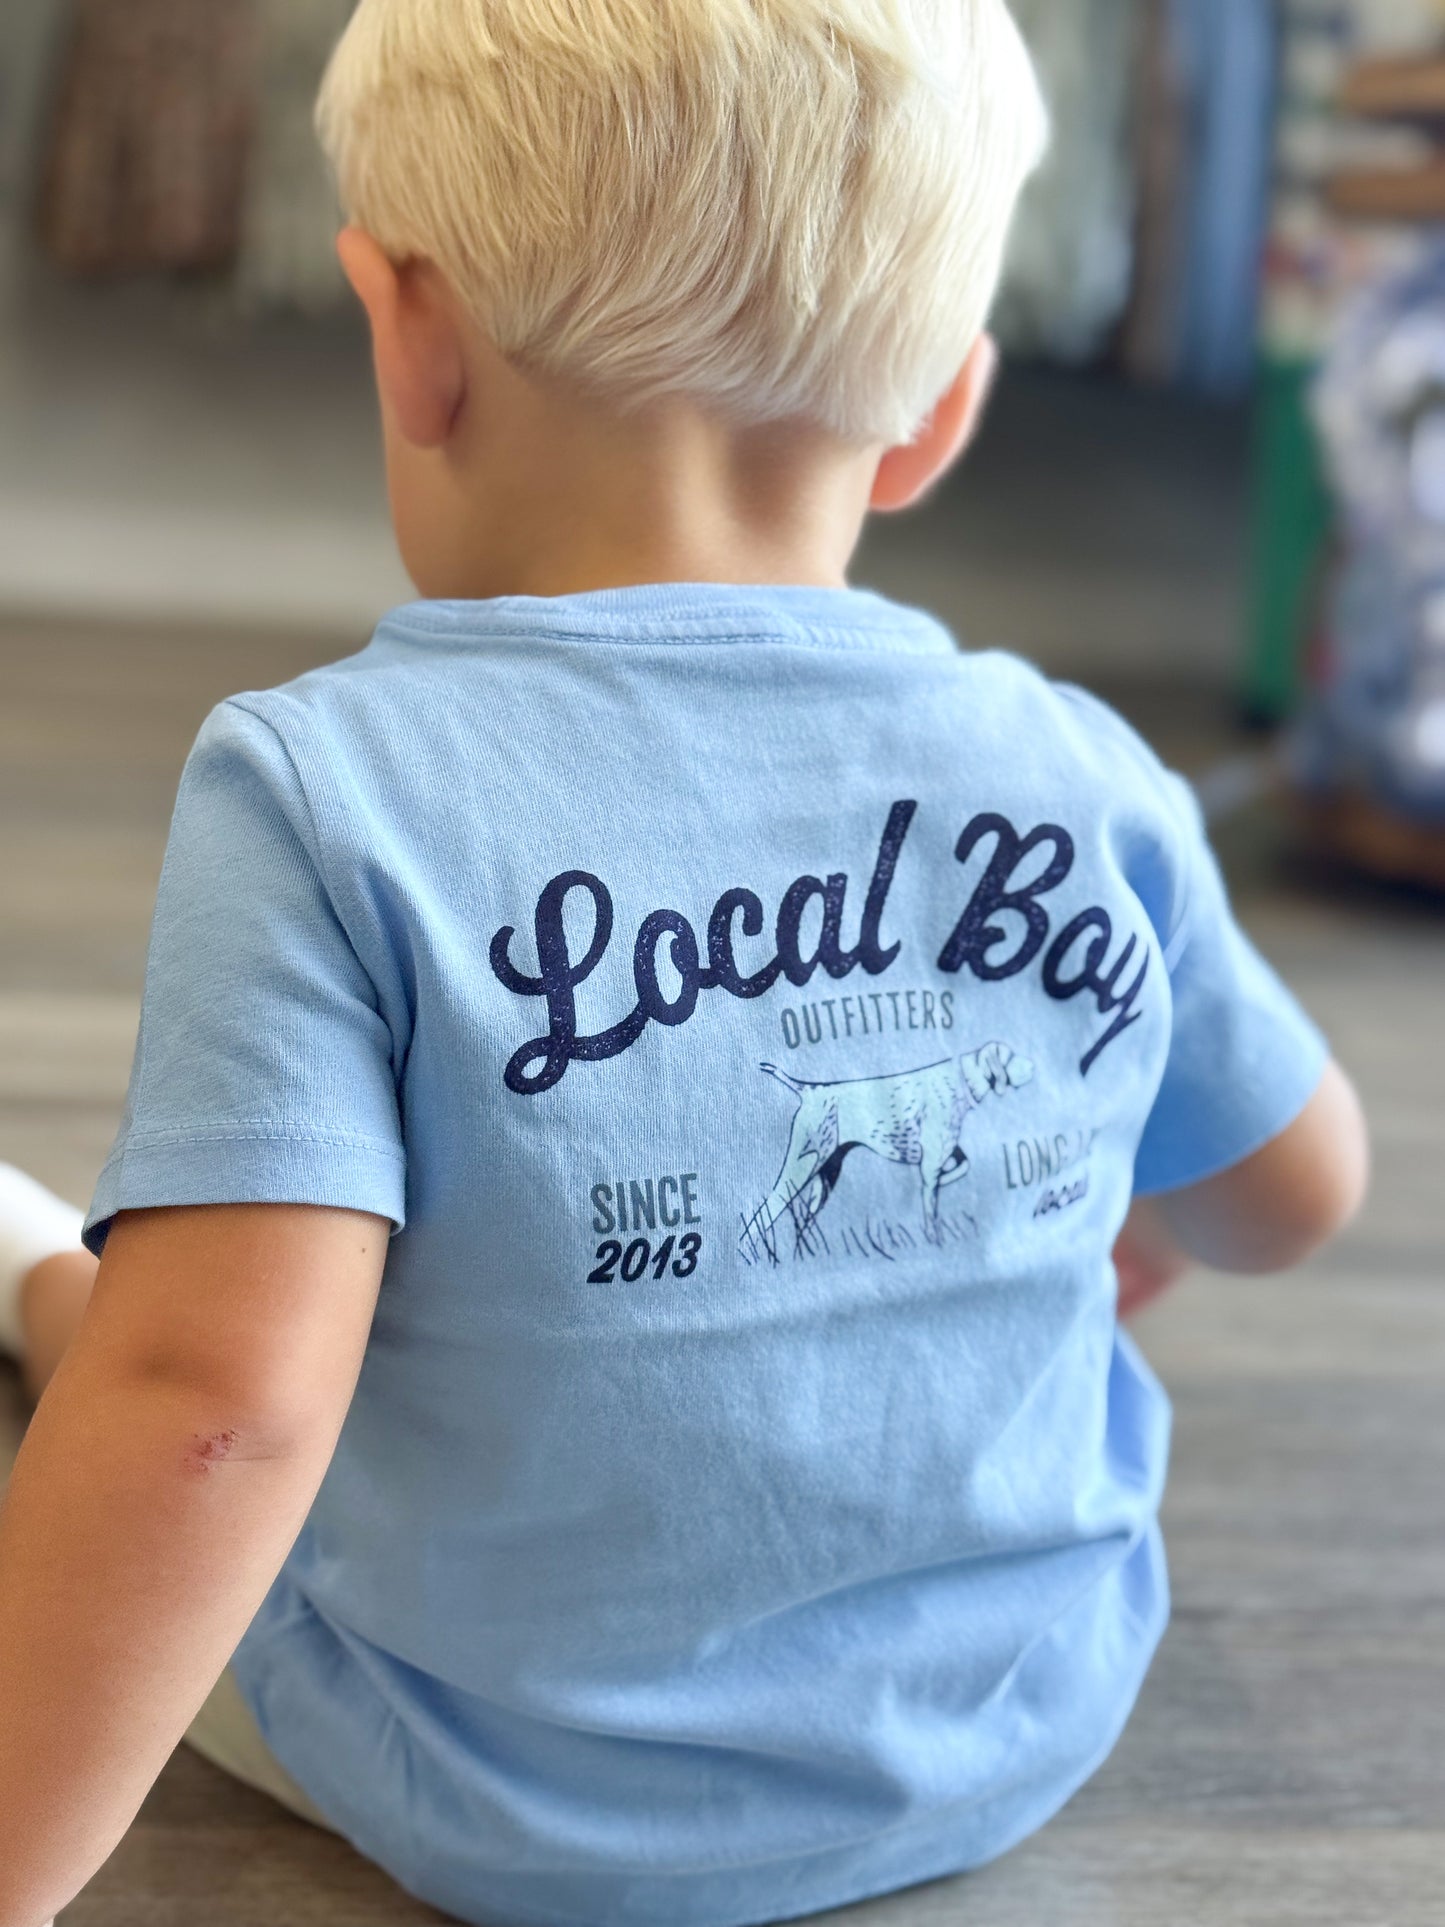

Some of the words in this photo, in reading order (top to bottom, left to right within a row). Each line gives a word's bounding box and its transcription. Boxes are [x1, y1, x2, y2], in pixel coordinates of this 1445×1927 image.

[490, 800, 917, 1095] Local
[938, 813, 1149, 1077] Boy
[782, 990, 954, 1049] OUTFITTERS
[590, 1173, 701, 1233] SINCE
[587, 1232, 703, 1284] 2013
